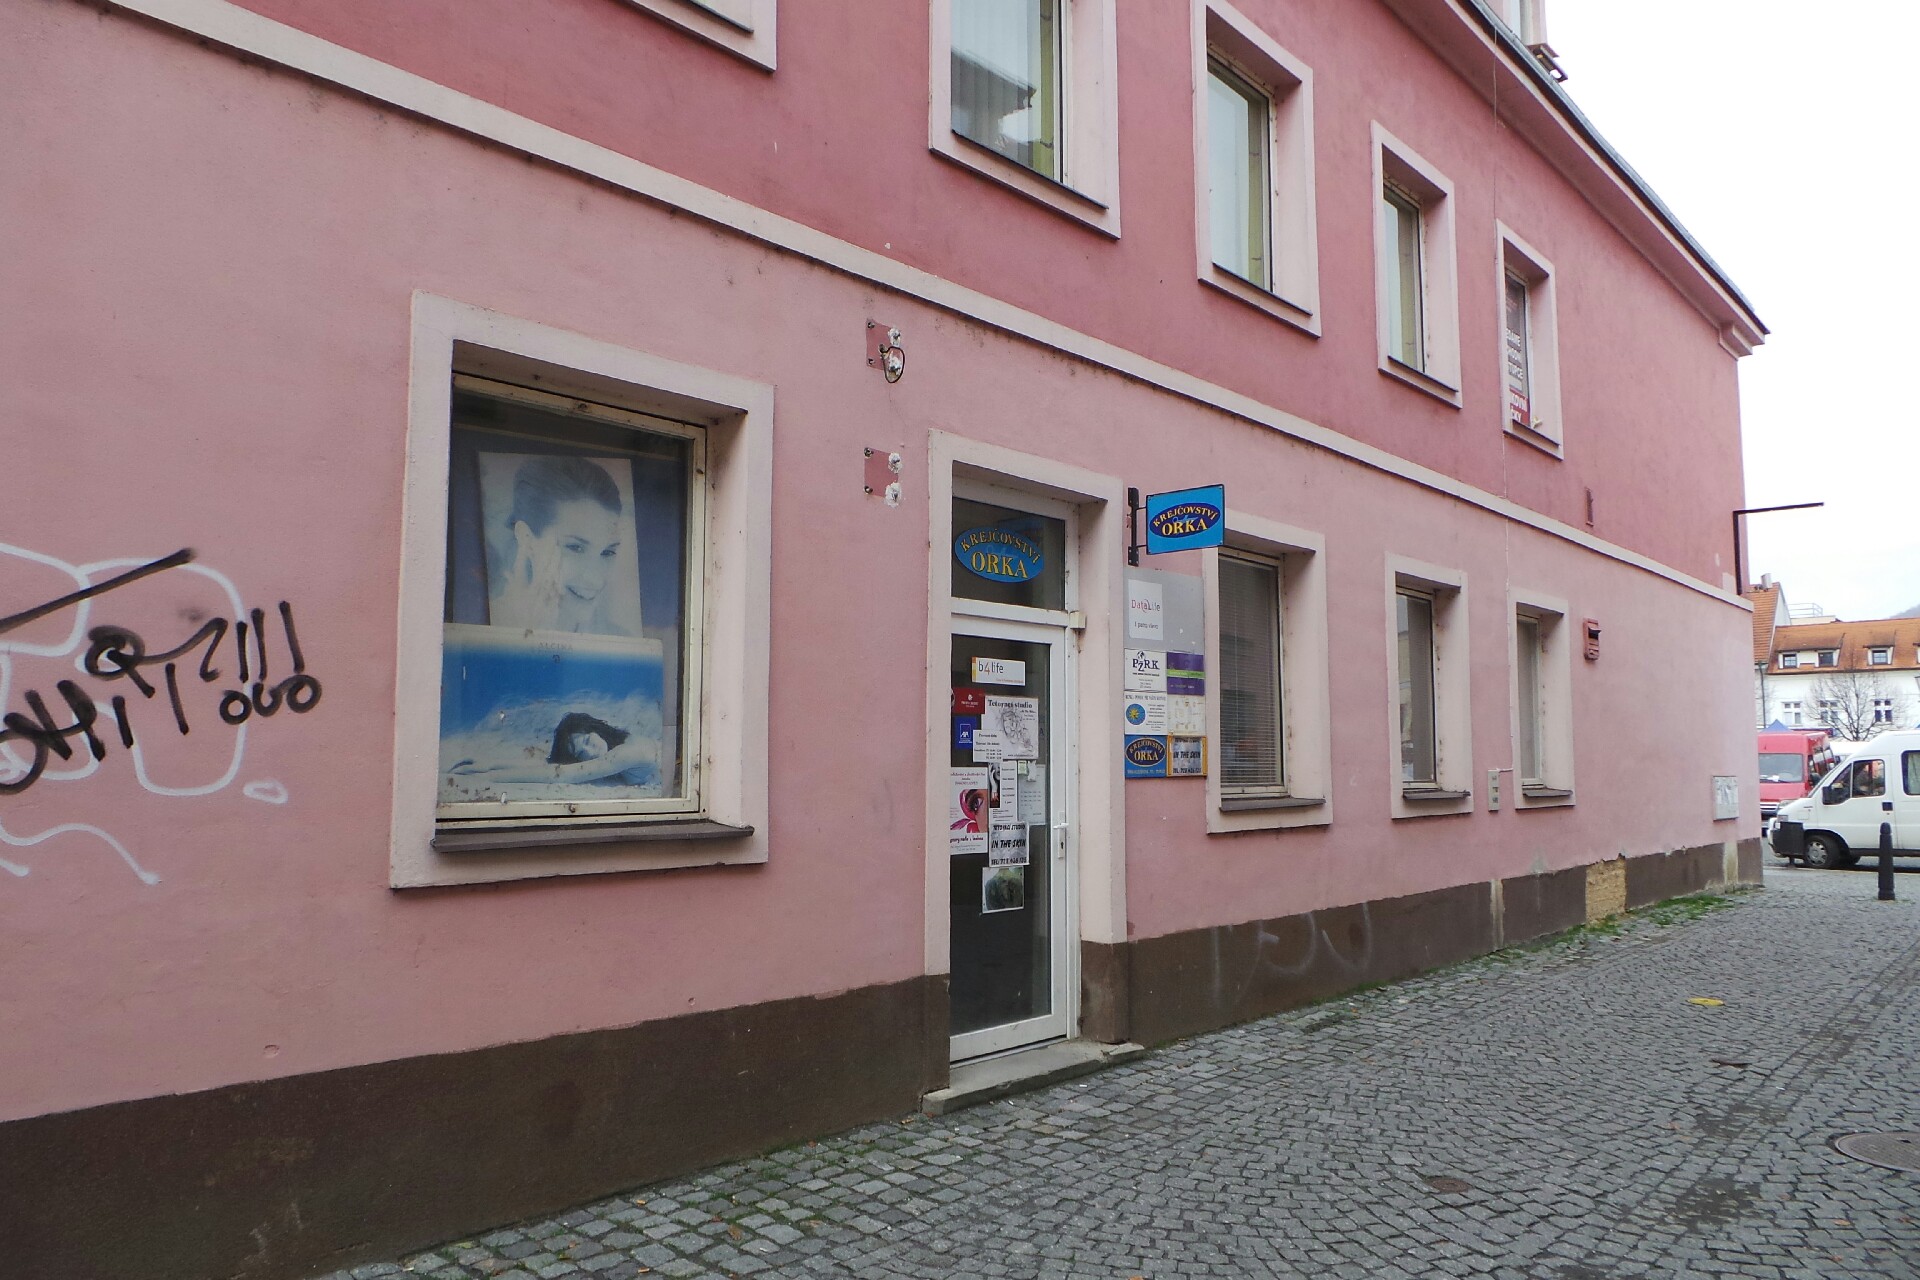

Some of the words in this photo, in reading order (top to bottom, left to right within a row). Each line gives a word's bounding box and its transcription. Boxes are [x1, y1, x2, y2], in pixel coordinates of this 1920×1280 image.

[1153, 506, 1218, 528] KREJČOVSTVÍ
[1162, 517, 1207, 536] ORKA
[961, 528, 1041, 564] KREJČOVSTVÍ
[972, 551, 1028, 579] ORKA
[1134, 751, 1159, 761] ORKA
[991, 840, 999, 848] IN
[1000, 839, 1011, 848] THE
[1012, 838, 1027, 848] SKIN
